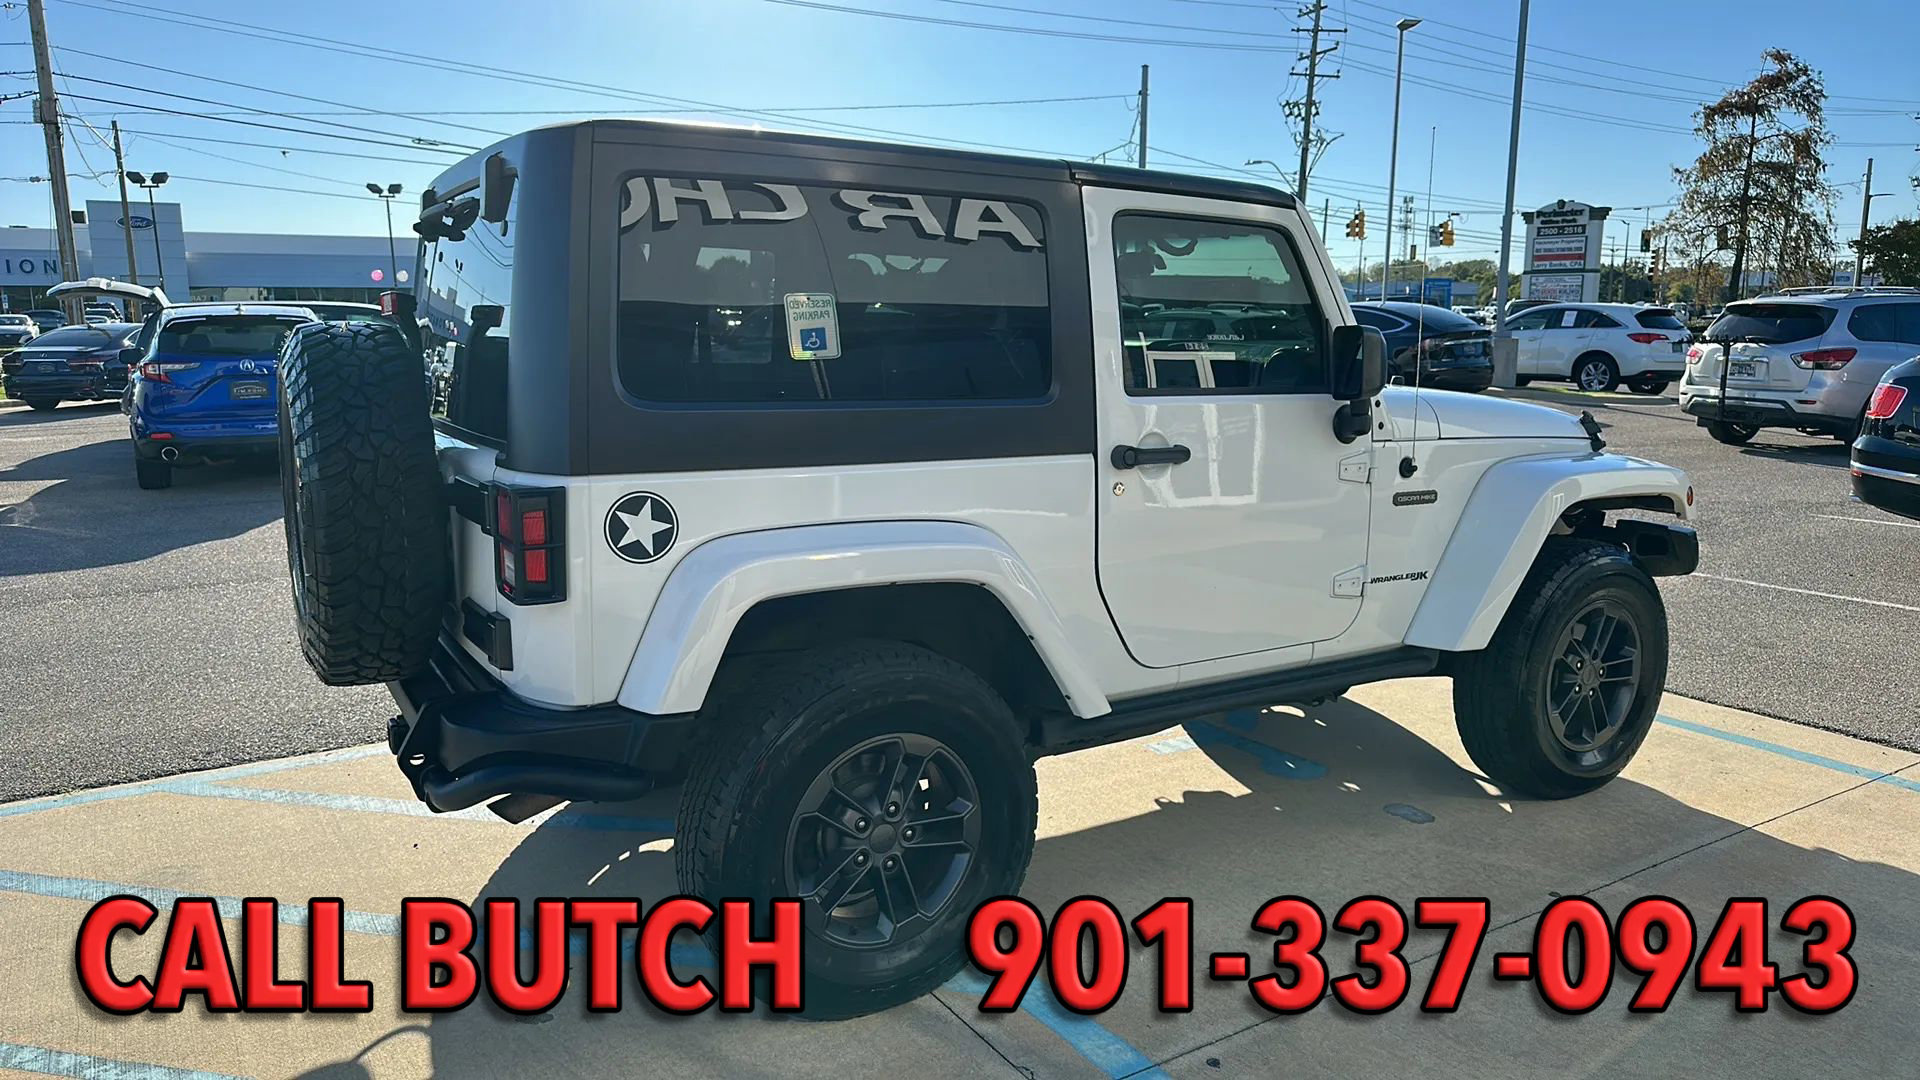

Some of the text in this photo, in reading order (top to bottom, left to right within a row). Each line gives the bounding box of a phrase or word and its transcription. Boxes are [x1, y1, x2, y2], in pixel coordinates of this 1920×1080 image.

[1536, 208, 1585, 218] Perimeter
[5, 259, 58, 274] ION
[1420, 493, 1436, 501] MIKE
